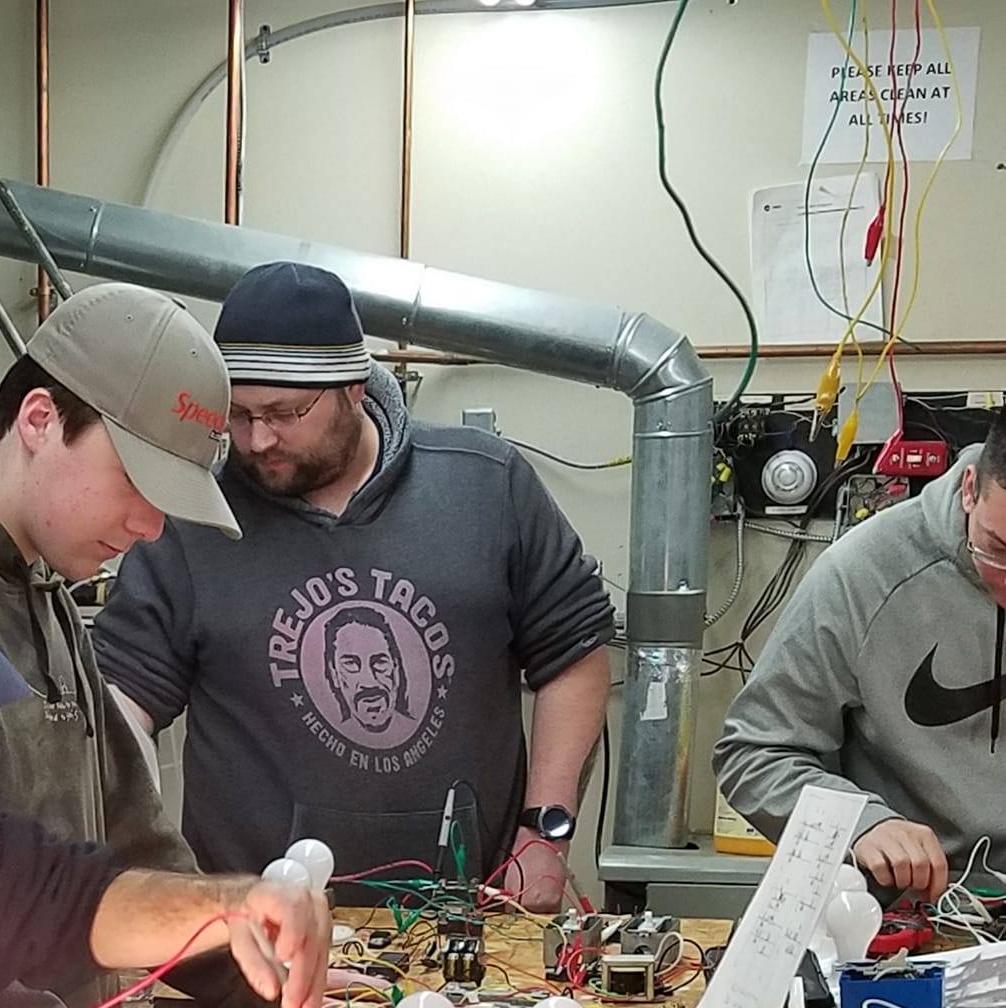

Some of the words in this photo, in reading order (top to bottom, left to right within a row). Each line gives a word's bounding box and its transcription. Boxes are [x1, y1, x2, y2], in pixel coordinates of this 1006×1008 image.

[831, 65, 882, 78] PLEASE
[926, 62, 951, 75] ALL
[830, 89, 876, 102] AREAS
[881, 88, 927, 101] CLEAN
[931, 86, 951, 99] AT
[849, 113, 873, 126] ALL
[269, 567, 359, 688] TREJO'S
[371, 568, 455, 681] TACOS
[302, 712, 345, 757] HECHO
[350, 750, 369, 770] EN
[375, 756, 401, 773] LOS
[405, 706, 445, 768] ANGELES
